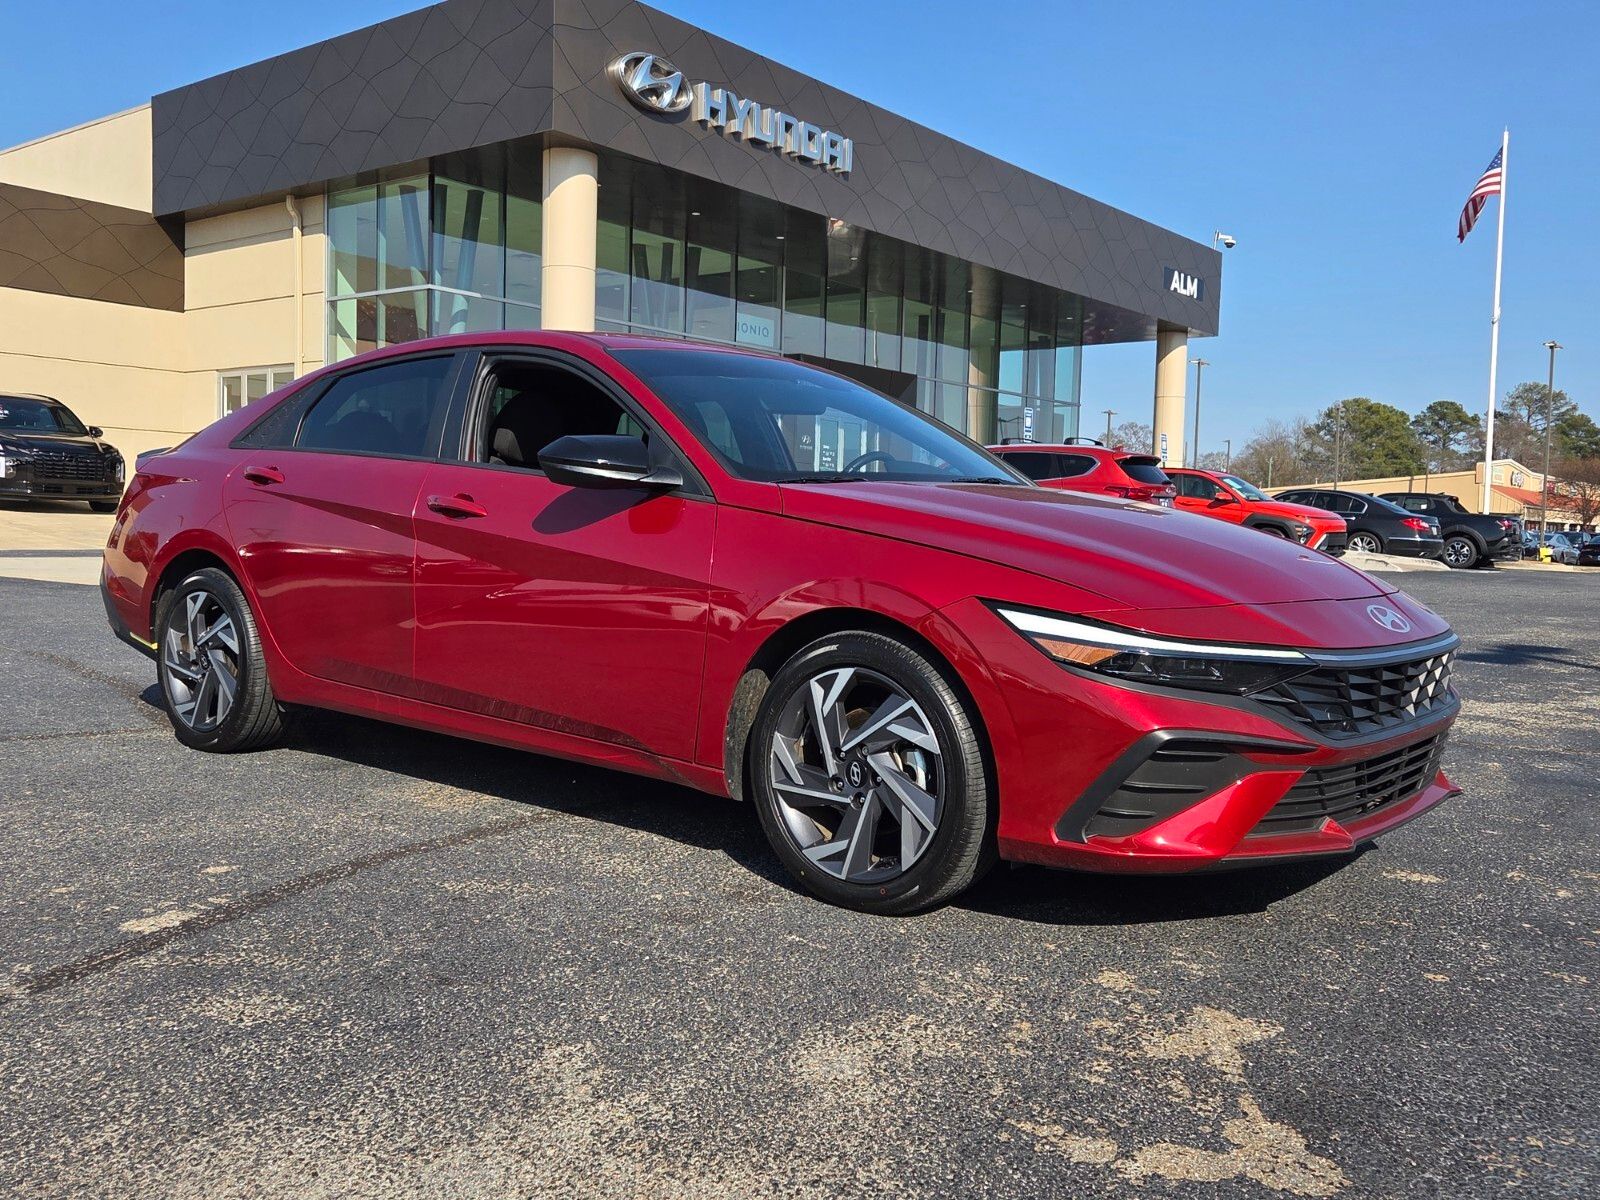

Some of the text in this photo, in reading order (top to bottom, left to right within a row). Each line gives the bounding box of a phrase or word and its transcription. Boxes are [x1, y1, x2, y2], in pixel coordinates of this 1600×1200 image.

[693, 82, 853, 172] HYUNDAI
[1170, 270, 1198, 299] ALM
[737, 321, 769, 338] IONIQ
